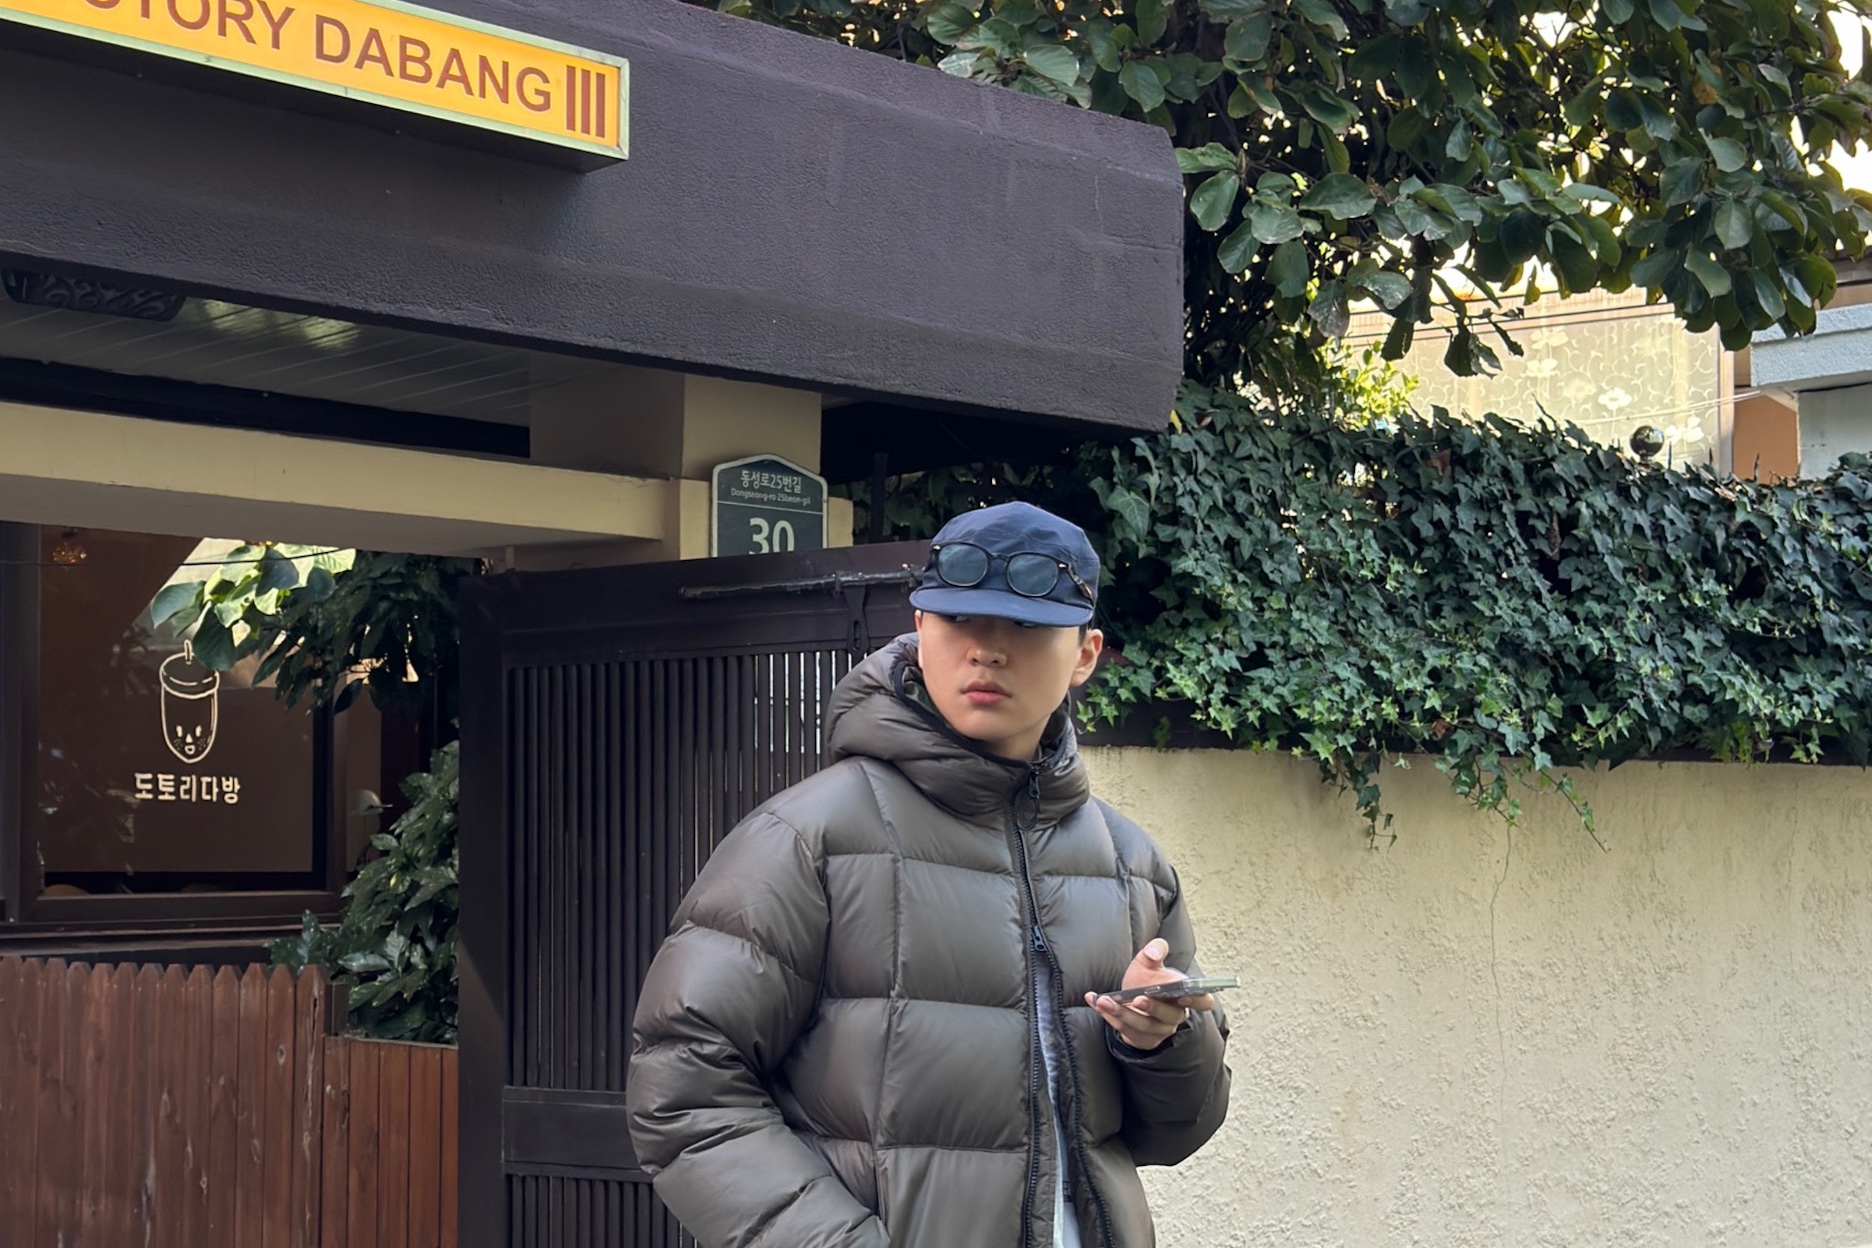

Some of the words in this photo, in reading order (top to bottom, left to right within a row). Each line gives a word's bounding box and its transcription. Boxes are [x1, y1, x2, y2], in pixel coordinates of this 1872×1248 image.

[84, 0, 295, 50] ORY
[315, 14, 551, 112] DABANG
[741, 470, 802, 494] 동성로25번길
[749, 517, 795, 555] 30
[134, 772, 241, 804] 도토리다방
